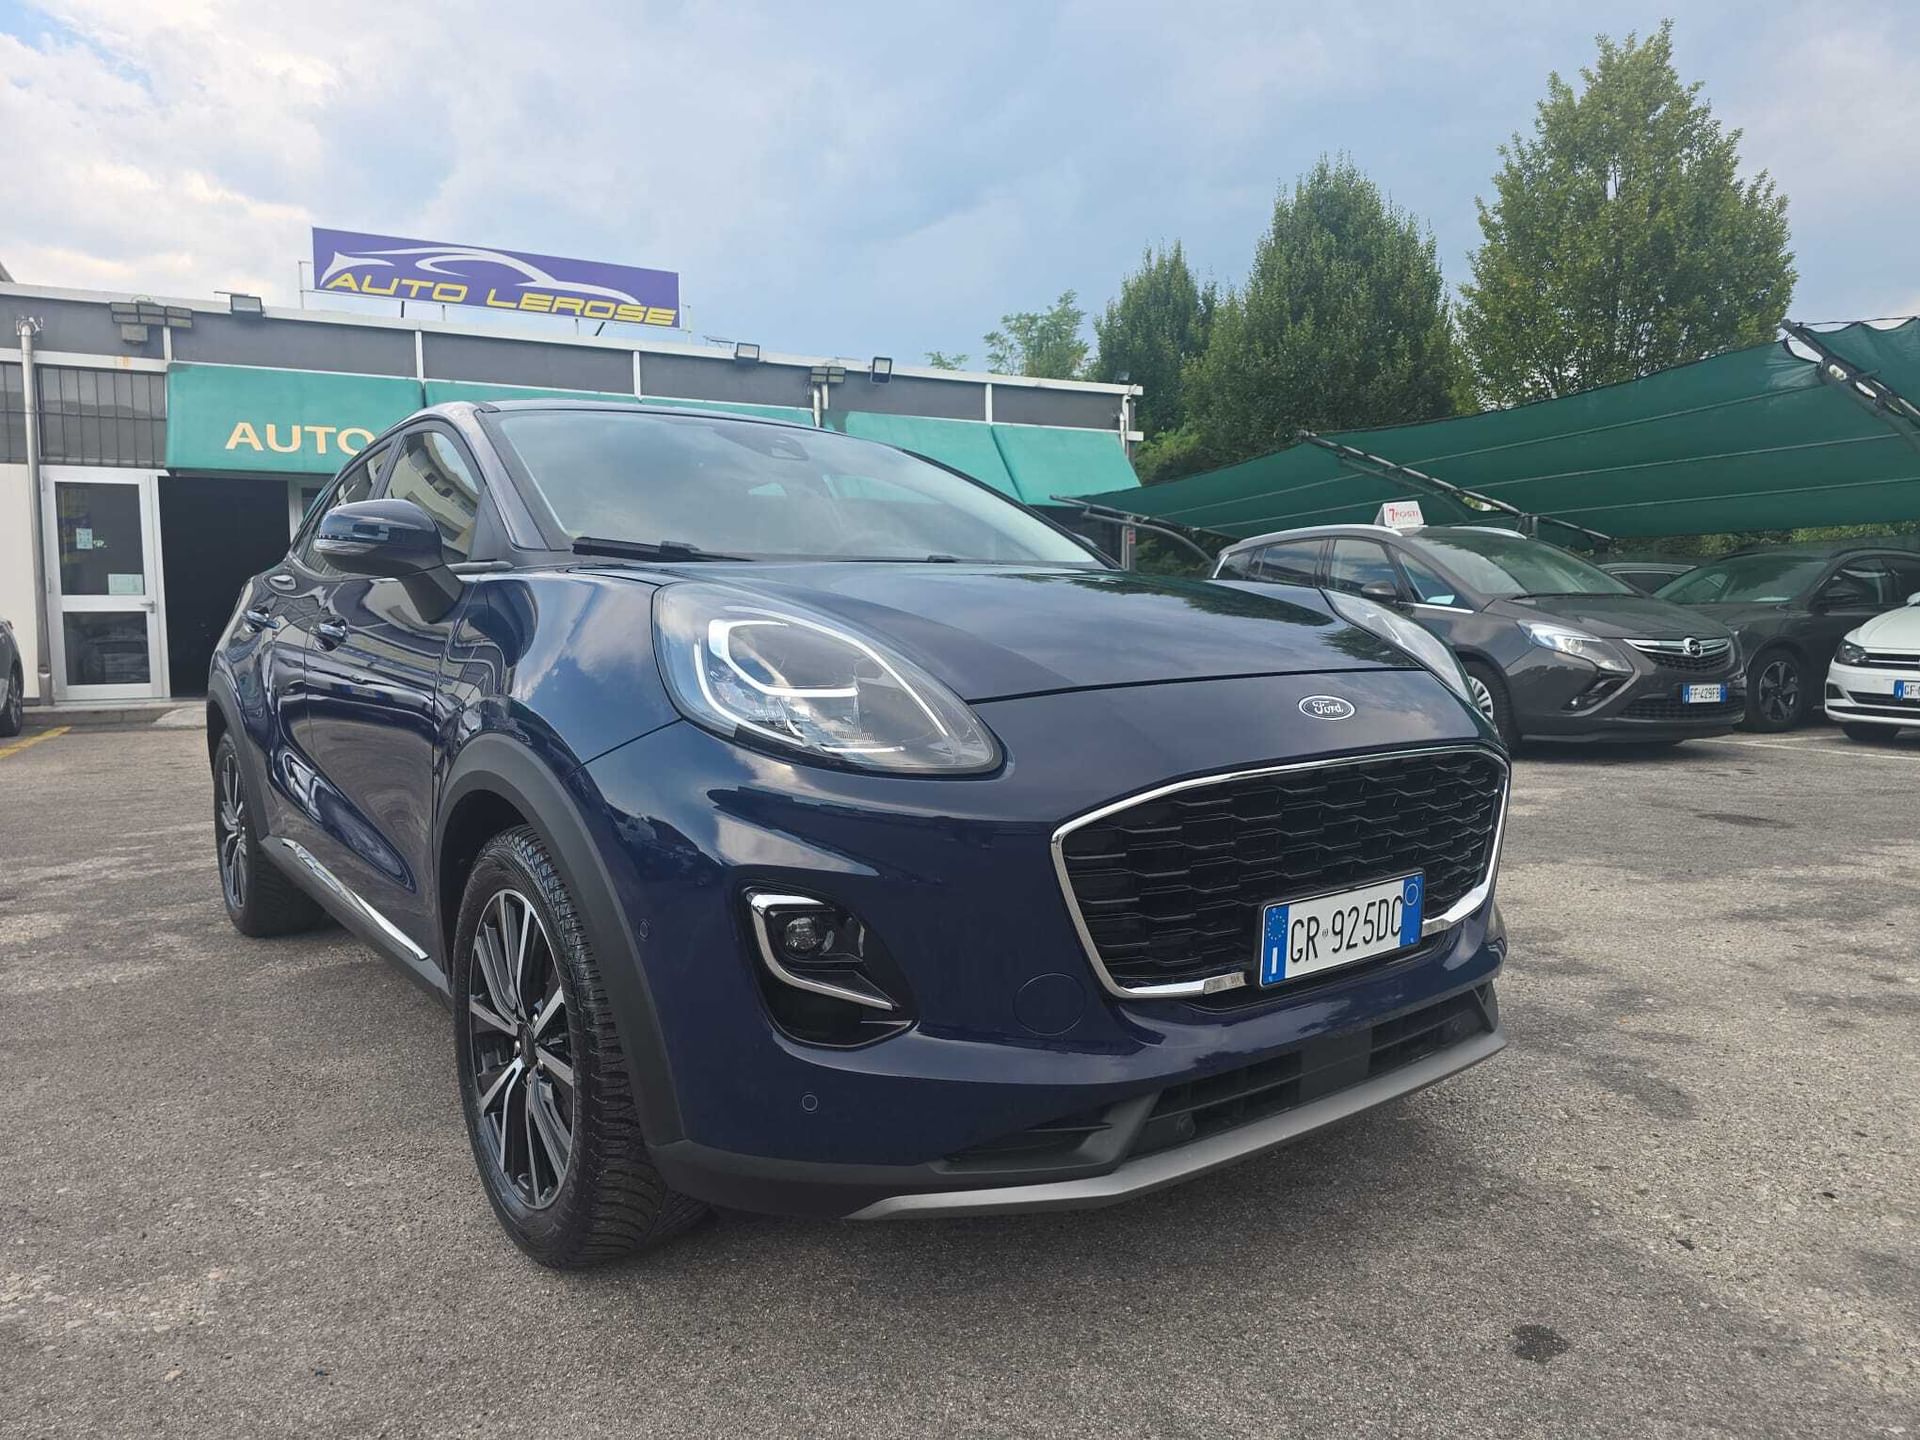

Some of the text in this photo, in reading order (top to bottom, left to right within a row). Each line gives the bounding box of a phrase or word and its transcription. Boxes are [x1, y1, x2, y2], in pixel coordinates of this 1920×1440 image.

[325, 272, 677, 326] AUTO LEROSE
[225, 422, 376, 456] AUTO
[1312, 700, 1344, 715] Ford
[1290, 915, 1320, 963] GR
